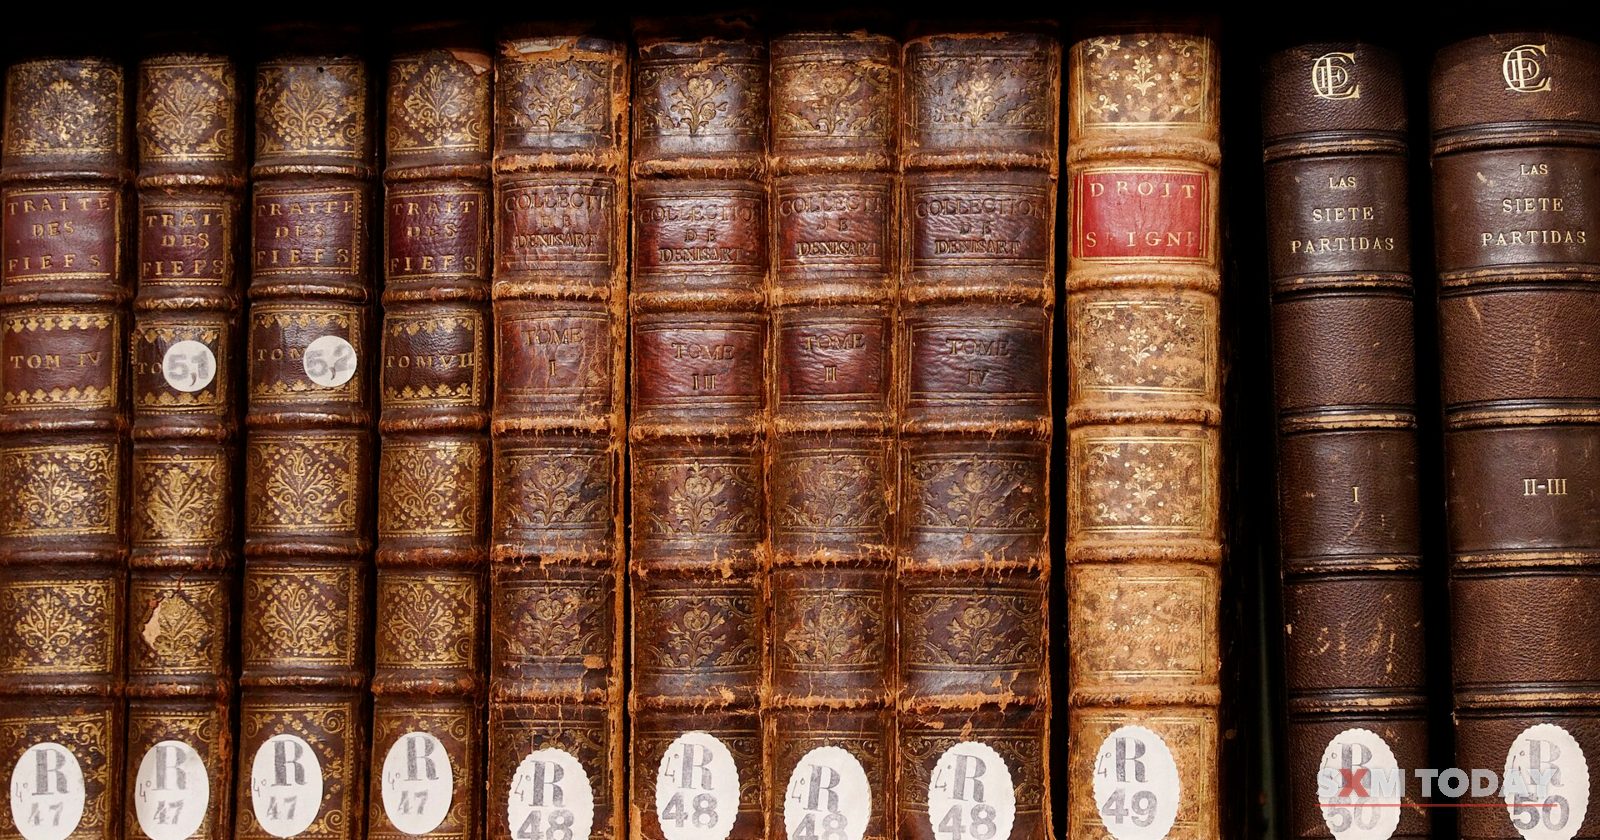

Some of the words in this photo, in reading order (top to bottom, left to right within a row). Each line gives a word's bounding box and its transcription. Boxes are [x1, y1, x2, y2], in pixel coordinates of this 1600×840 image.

[1519, 164, 1549, 176] LAS
[1090, 181, 1195, 198] DROIT
[1328, 176, 1356, 189] LAS
[393, 201, 474, 215] TRAIT
[916, 198, 1045, 219] COLLECTION
[1313, 207, 1374, 222] SIETE
[1503, 198, 1564, 213] SIETE
[32, 221, 75, 239] DES
[275, 223, 326, 239] DES
[406, 223, 457, 239] DES
[684, 229, 717, 242] DE
[1481, 230, 1586, 246] PARTIDAS
[161, 233, 209, 249] DES
[514, 232, 598, 249] DENISART
[796, 241, 877, 256] DENISART
[935, 240, 1020, 255] DENISART
[1291, 237, 1394, 254] PARTIDAS
[8, 254, 101, 272] FIEFS
[256, 248, 349, 266] FIEFS
[389, 255, 475, 272] FIEFS
[658, 247, 744, 263] DENISART
[143, 260, 224, 276] FIEFS
[521, 328, 584, 346] TOME
[805, 333, 866, 350] TOME
[672, 342, 735, 361] TOME
[946, 338, 1010, 356] TOME
[10, 355, 62, 369] TOM
[77, 352, 101, 367] IV
[138, 362, 163, 375] TO
[386, 355, 433, 368] TOM
[549, 359, 557, 376] I
[692, 373, 716, 391] III
[824, 365, 838, 383] II
[966, 369, 990, 386] IV
[1352, 486, 1360, 503] I
[1523, 478, 1568, 496] II-III
[271, 739, 308, 787] R
[404, 736, 440, 782] R
[679, 743, 716, 790] R
[1113, 736, 1149, 783] R
[31, 748, 69, 796] R
[151, 746, 189, 791] R
[529, 760, 571, 807] R
[948, 753, 987, 803] R
[803, 764, 842, 813] R
[266, 795, 298, 821] 47
[398, 789, 429, 815] 47
[662, 791, 719, 829] 48
[1101, 787, 1158, 828] 49
[29, 801, 64, 827] 47
[153, 800, 185, 825] 47
[1327, 797, 1381, 833] 50
[1512, 793, 1570, 831] 50
[516, 809, 575, 840] 48
[938, 803, 997, 840] 48
